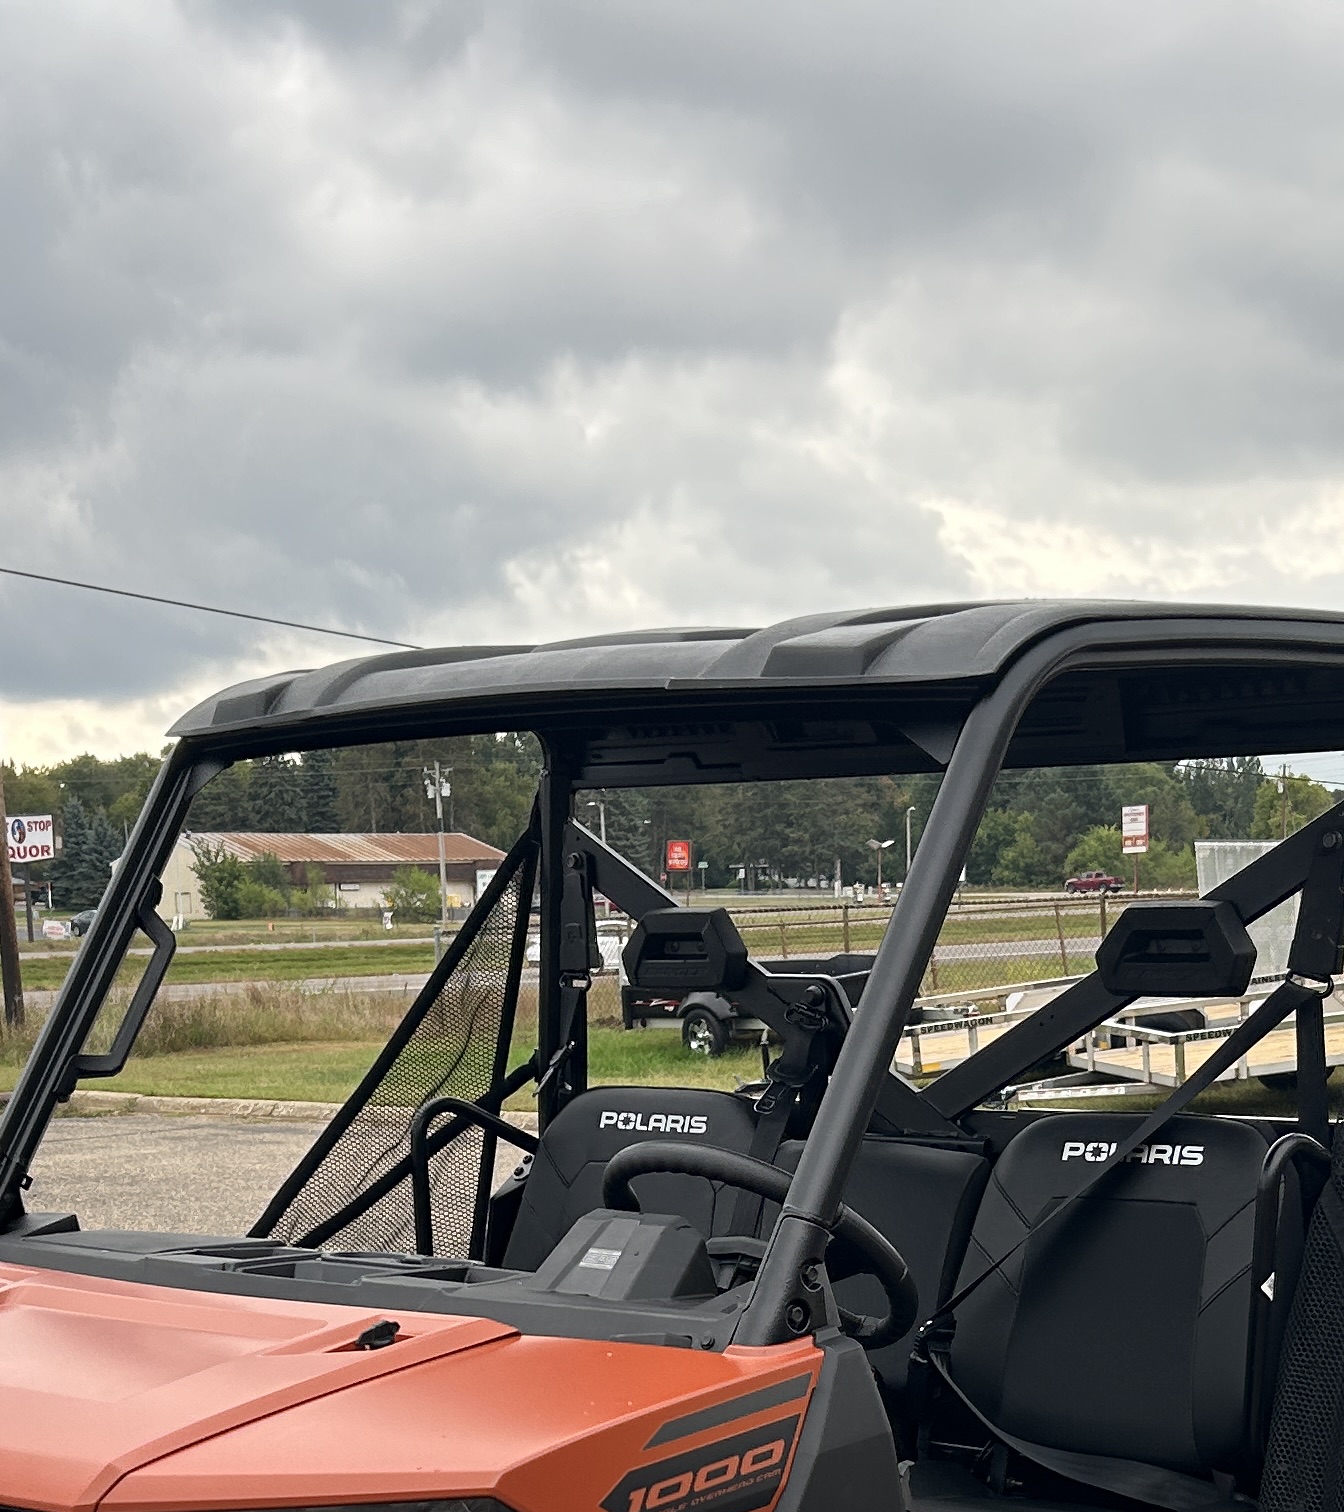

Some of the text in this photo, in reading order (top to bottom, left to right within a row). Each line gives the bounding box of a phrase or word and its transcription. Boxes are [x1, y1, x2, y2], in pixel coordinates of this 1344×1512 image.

[26, 820, 51, 832] STOP
[7, 844, 51, 859] QUOR
[920, 1016, 993, 1034] SPEEDWAGON
[1185, 1028, 1239, 1042] SPEEDW
[599, 1111, 708, 1134] POLARIS
[690, 1477, 754, 1506] OVERHEAD
[756, 1468, 782, 1483] CAM
